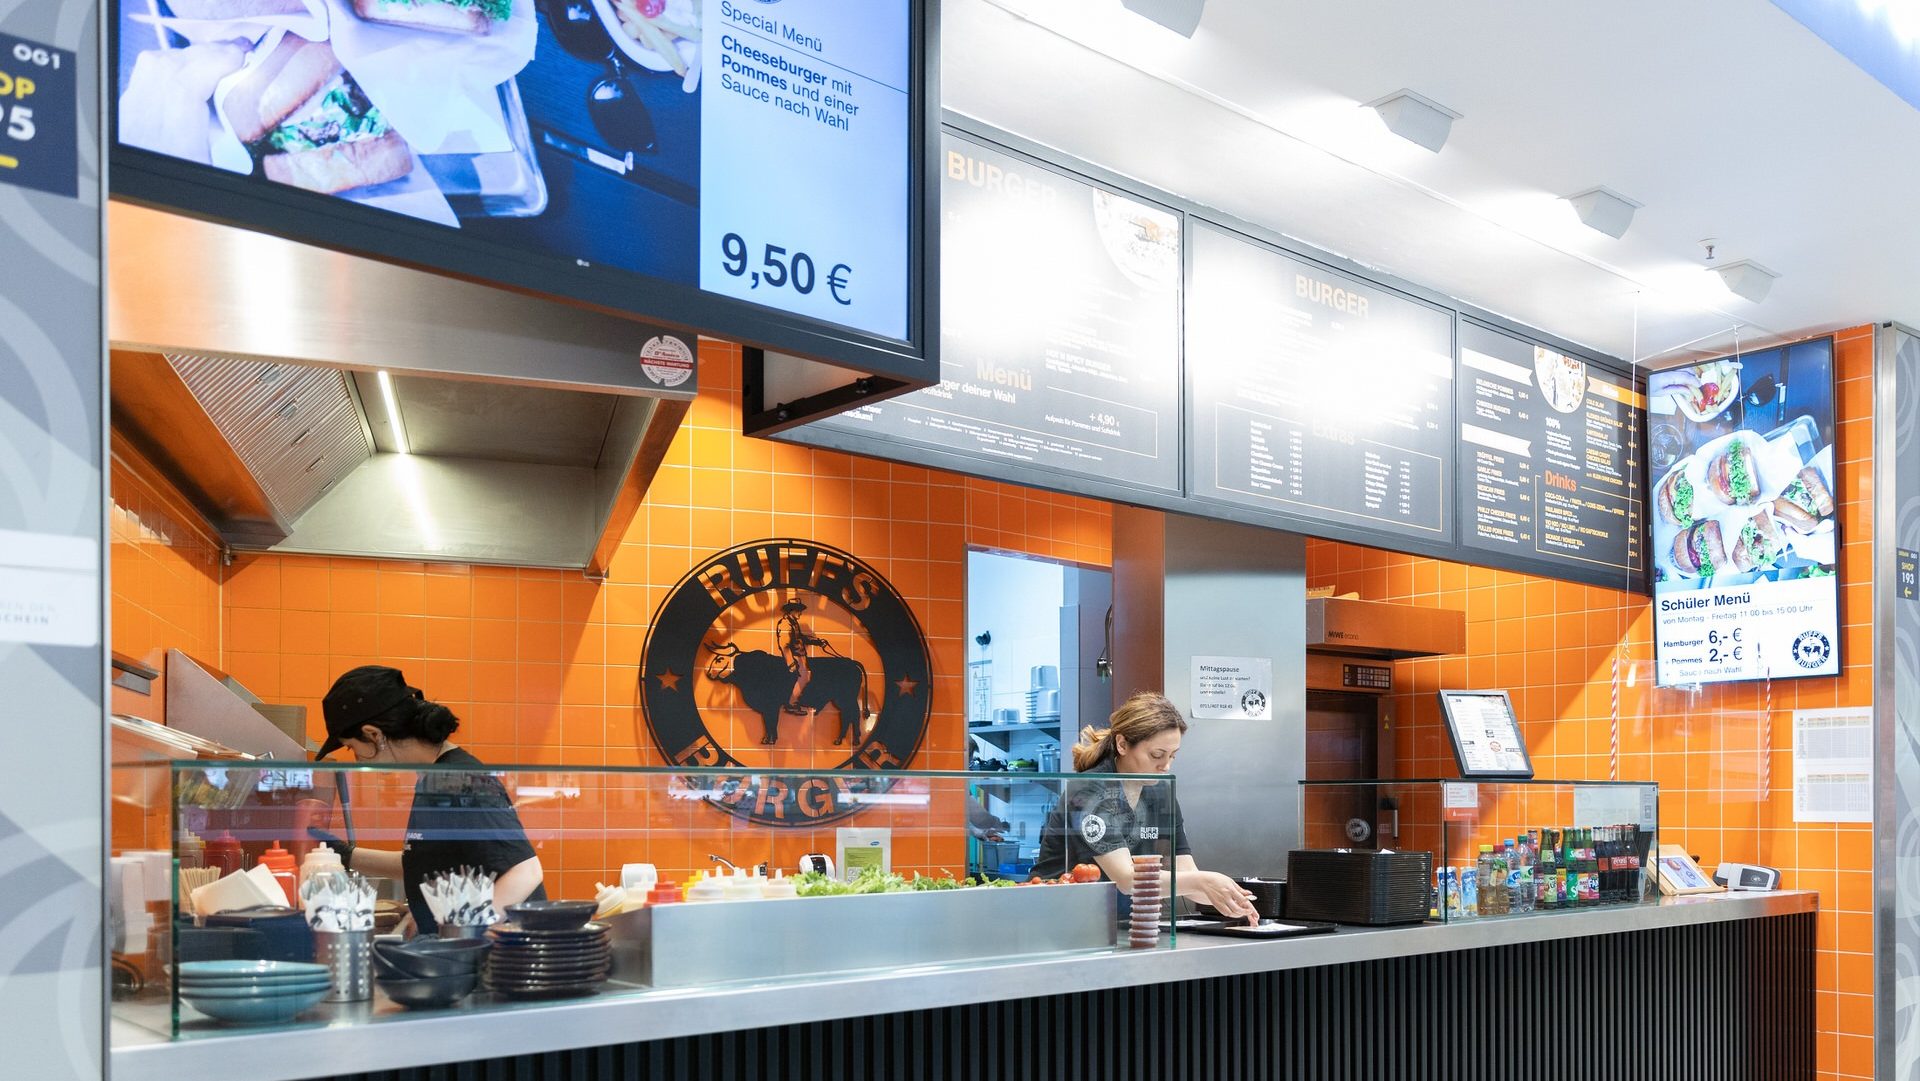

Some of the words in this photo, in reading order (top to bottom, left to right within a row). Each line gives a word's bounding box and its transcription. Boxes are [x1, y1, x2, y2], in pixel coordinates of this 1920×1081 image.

[722, 1, 777, 35] Special
[783, 24, 822, 52] Menü
[12, 43, 60, 70] OG1
[722, 35, 827, 86] Cheeseburger
[832, 78, 852, 96] mit
[722, 54, 787, 90] Pommes
[792, 82, 819, 102] und
[824, 95, 859, 116] einer
[722, 74, 769, 102] Sauce
[776, 95, 810, 117] nach
[815, 106, 848, 131] Wahl
[0, 104, 36, 141] 5
[948, 150, 1056, 210] BURGER
[722, 232, 815, 295] 9,50
[827, 263, 852, 306] €
[1296, 274, 1369, 318] BURGER
[976, 358, 1032, 391] Menü
[962, 382, 992, 398] deiner
[993, 388, 1015, 404] Wahl
[1098, 413, 1115, 426] 4,90
[1313, 417, 1354, 446] Extras
[1545, 470, 1576, 492] Drinks
[697, 548, 879, 610] RUFF'S
[1902, 572, 1914, 585] 193
[1661, 597, 1710, 611] Schüler
[1714, 592, 1750, 605] Menü
[1677, 615, 1704, 624] Montag
[1711, 612, 1736, 621] Freitag
[1799, 604, 1813, 613] Uhr
[1663, 638, 1703, 648] Hamburger
[1708, 630, 1728, 646] 6,-
[1733, 628, 1742, 642] €
[1709, 648, 1729, 664] 2,-
[1733, 646, 1743, 660] €
[674, 734, 900, 819] BRGR
